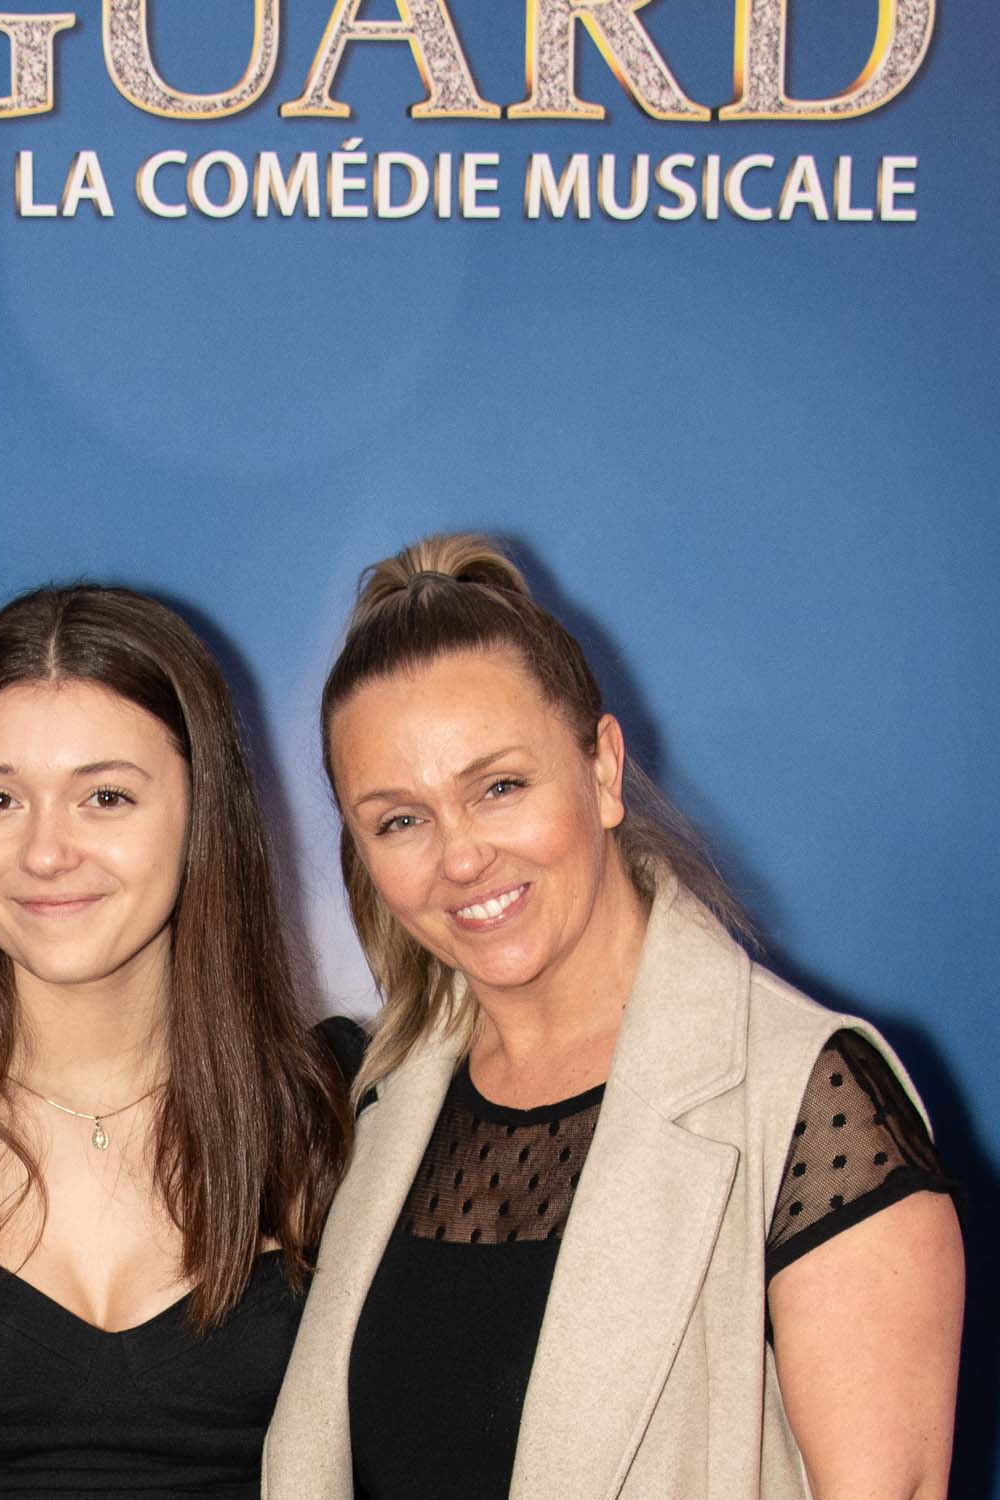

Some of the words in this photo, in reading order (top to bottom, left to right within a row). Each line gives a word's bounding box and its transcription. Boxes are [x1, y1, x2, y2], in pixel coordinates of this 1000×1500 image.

[15, 149, 115, 218] LA
[135, 138, 500, 220] COMÉDIE
[525, 153, 918, 222] MUSICALE
